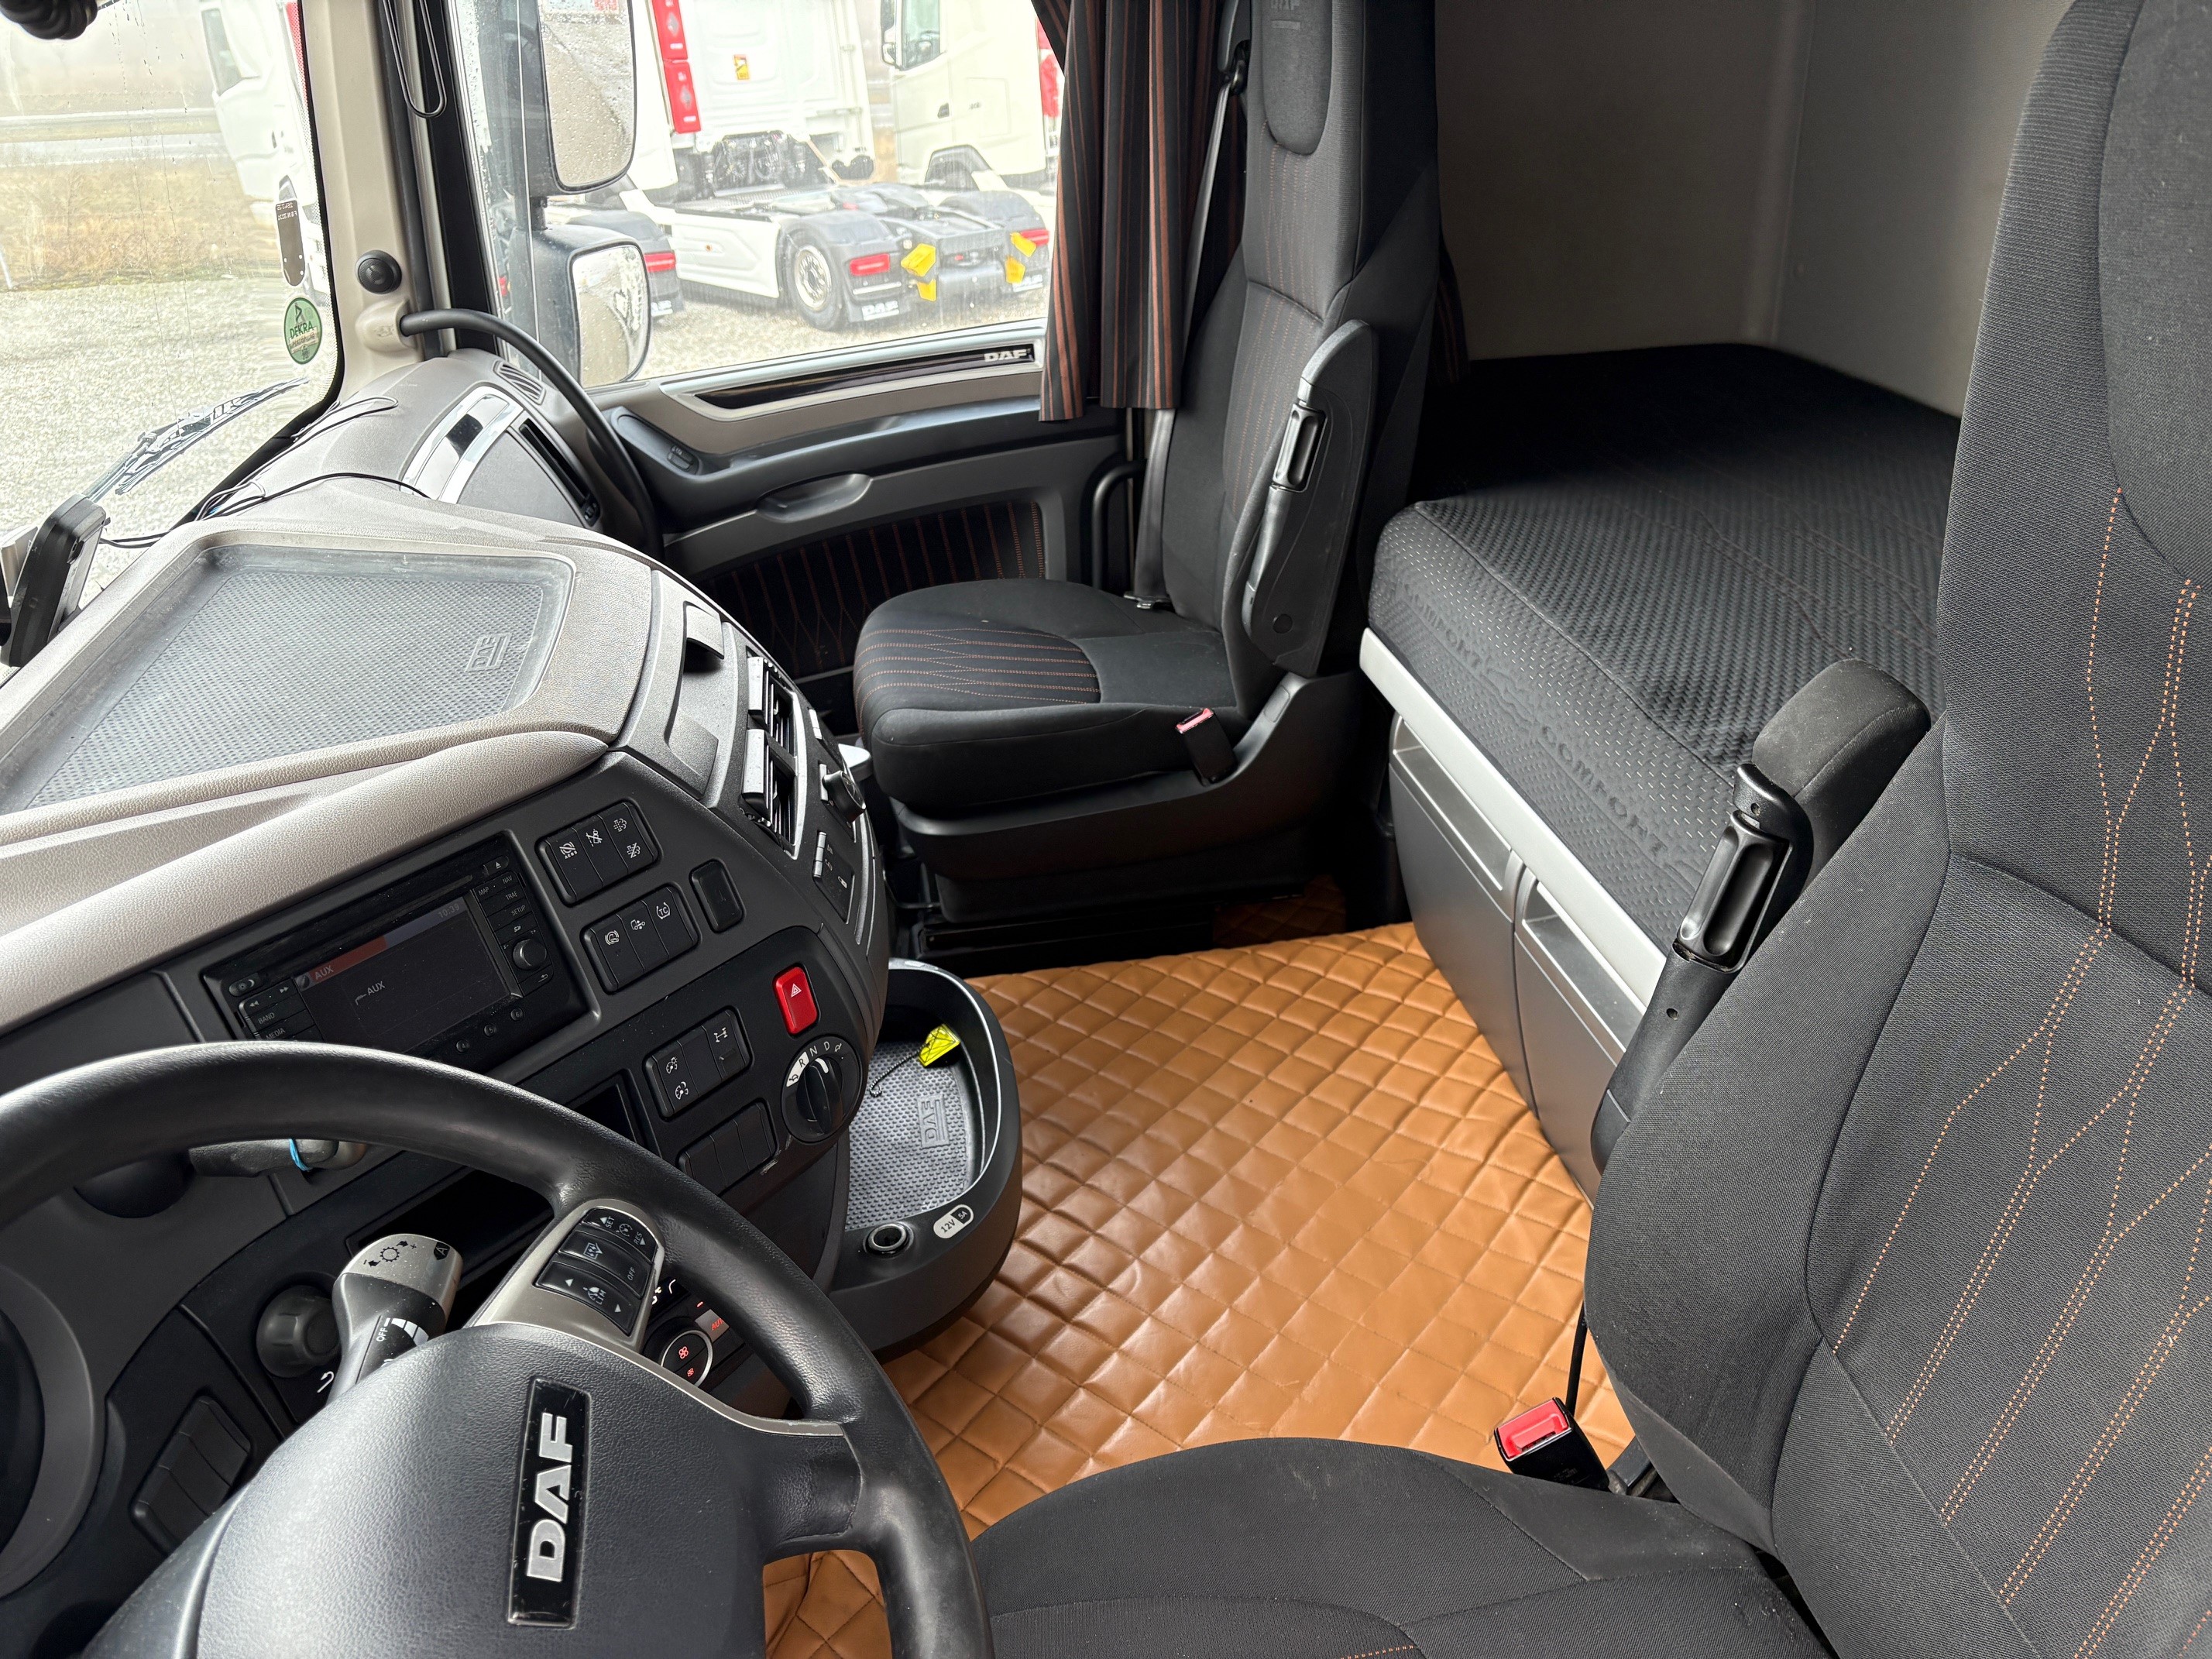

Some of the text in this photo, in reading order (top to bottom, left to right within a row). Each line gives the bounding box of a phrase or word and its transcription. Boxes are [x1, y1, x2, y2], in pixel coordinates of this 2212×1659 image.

[289, 321, 314, 339] DEKRA
[984, 349, 1028, 362] DAF
[478, 875, 513, 896] MAP NAV
[438, 904, 460, 919] 10:39
[511, 905, 526, 916] SETUP
[658, 906, 668, 916] TC
[314, 965, 334, 980] AUX
[367, 981, 386, 996] AUX
[258, 1012, 275, 1025] BAND
[266, 1027, 286, 1040] MEDIA
[799, 1041, 830, 1067] R N D
[606, 1216, 615, 1228] SET
[940, 1211, 967, 1234] 12V 5A
[634, 1232, 643, 1245] RES
[627, 1267, 636, 1280] OFF
[596, 1290, 606, 1305] LIM
[376, 1327, 388, 1341] OFF
[527, 1412, 573, 1582] DAF
